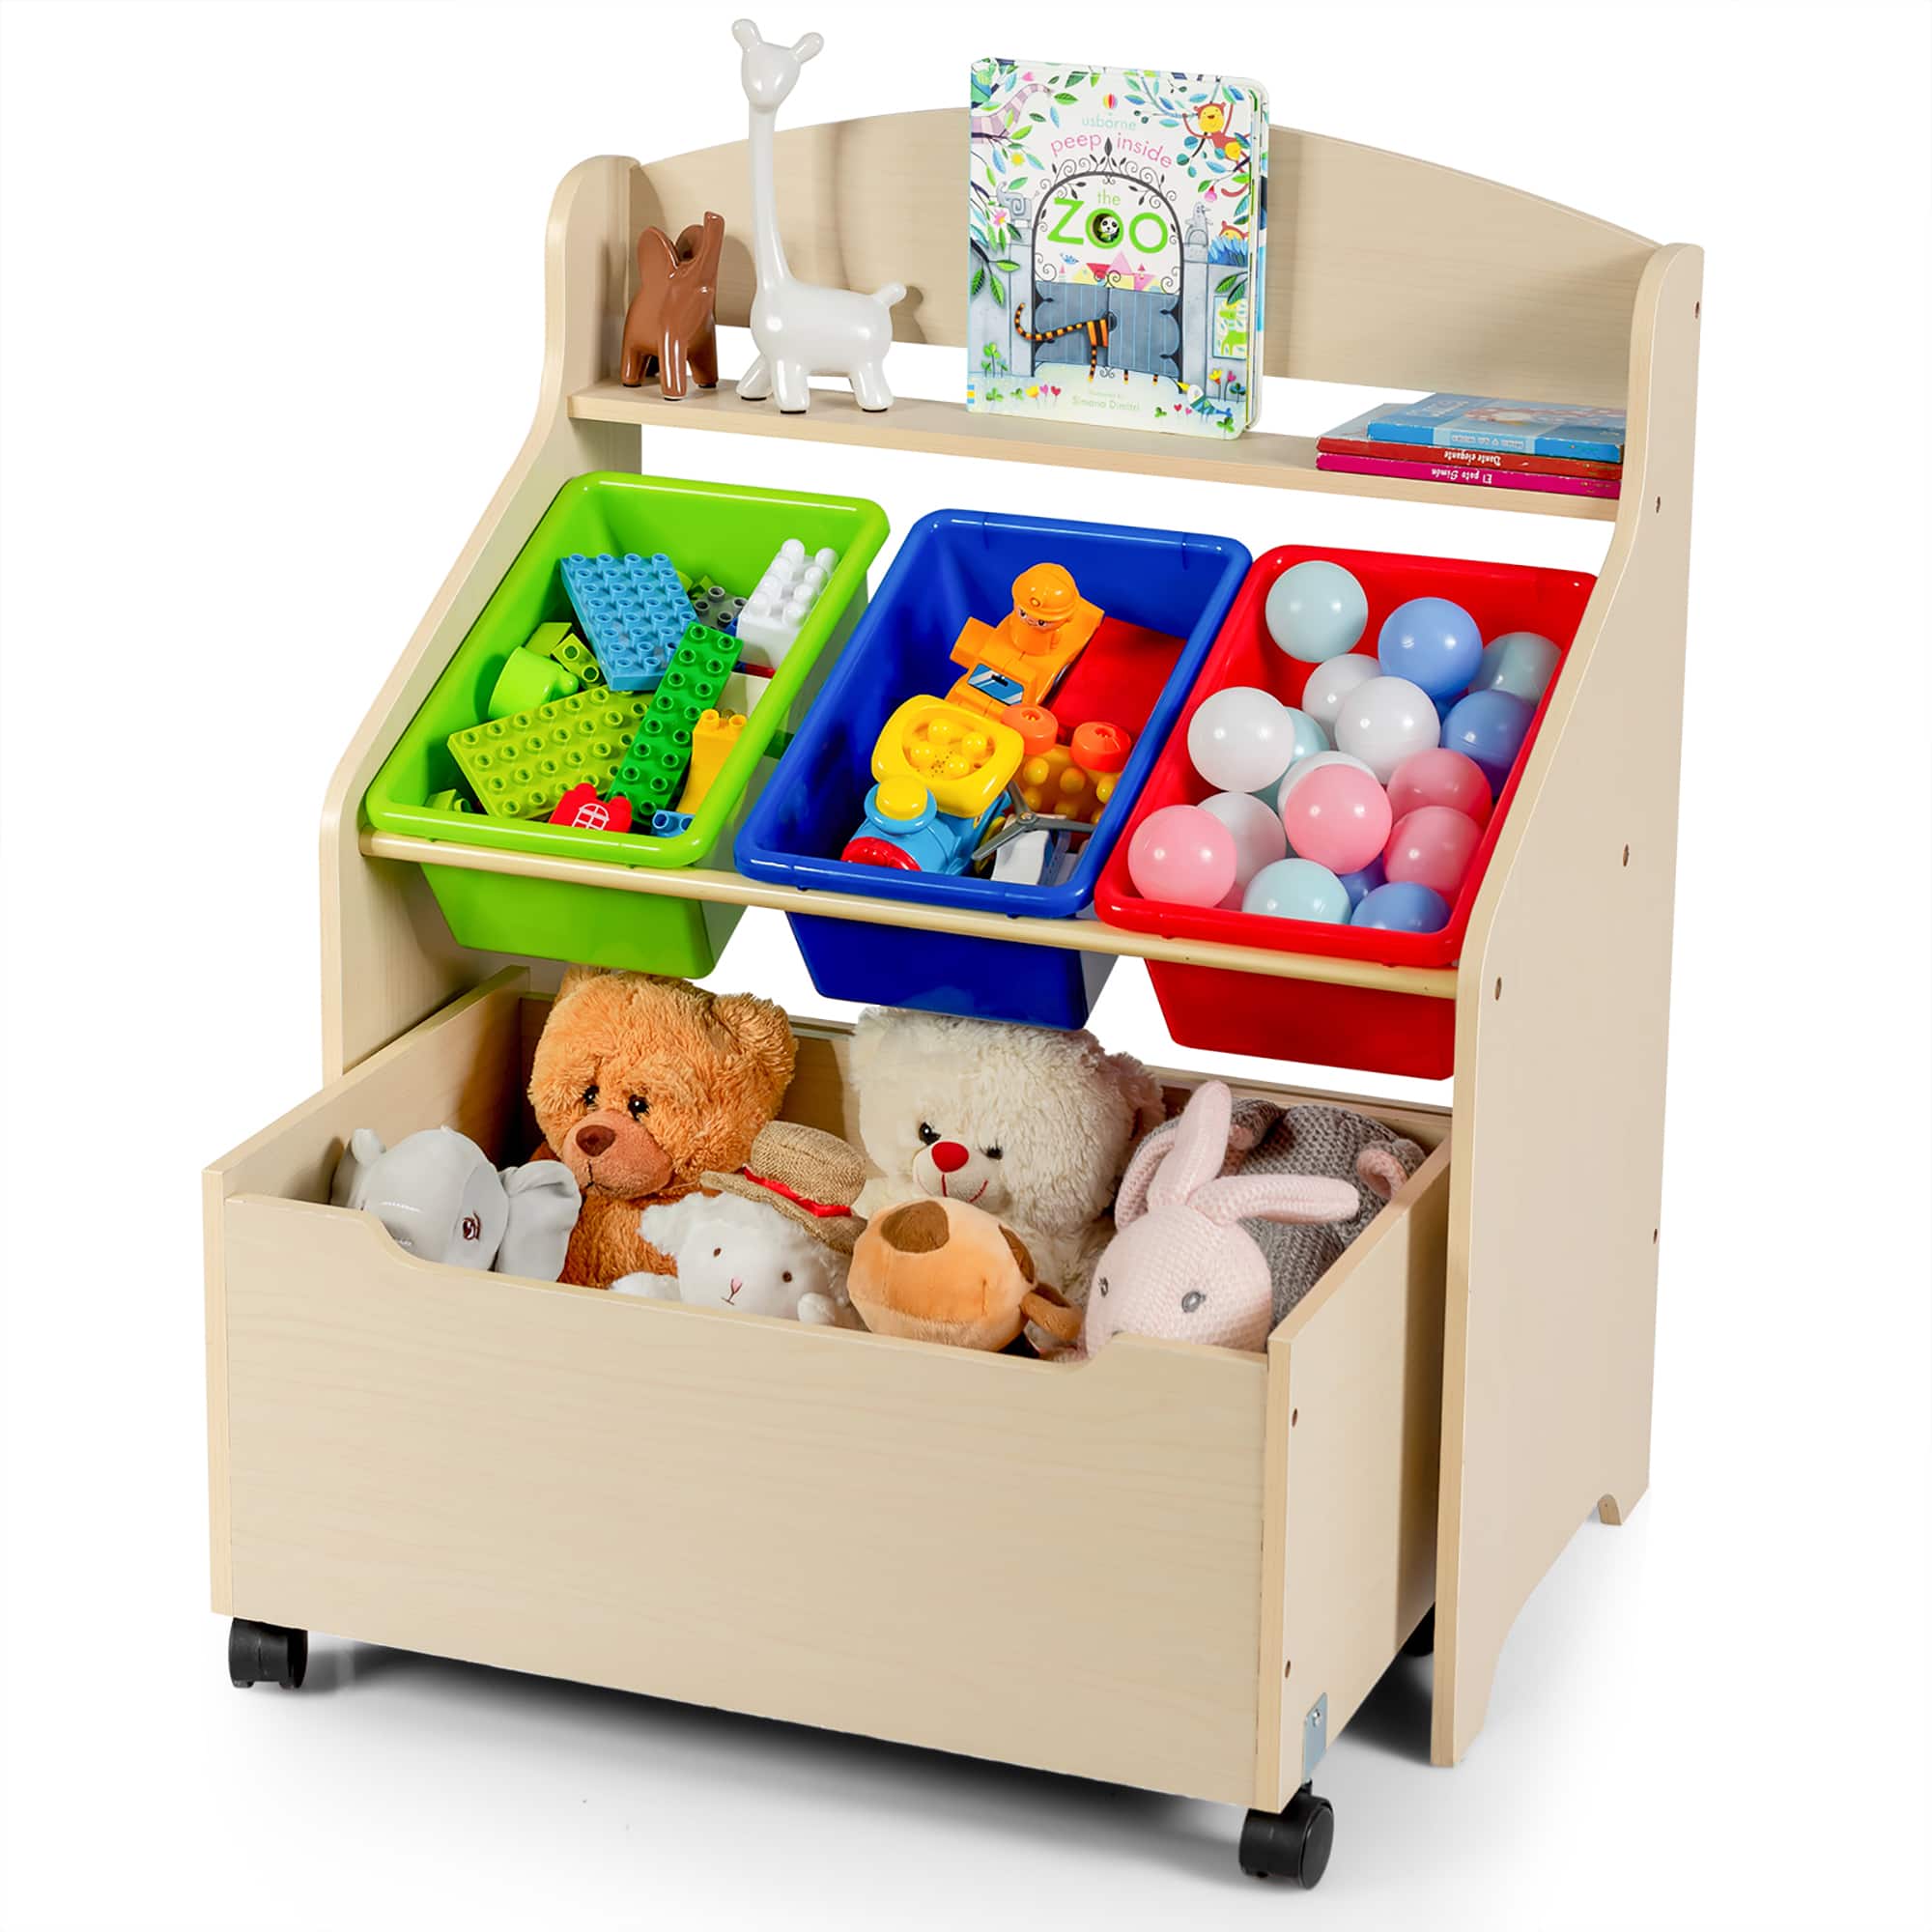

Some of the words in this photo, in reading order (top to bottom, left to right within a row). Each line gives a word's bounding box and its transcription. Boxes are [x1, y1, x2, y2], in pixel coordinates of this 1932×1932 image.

[1082, 114, 1137, 130] usborne
[1050, 133, 1102, 157] peep
[1117, 131, 1173, 168] inside
[1096, 188, 1122, 206] the
[1443, 449, 1477, 465] elegante
[1477, 455, 1501, 467] Dante
[1482, 473, 1492, 485] El
